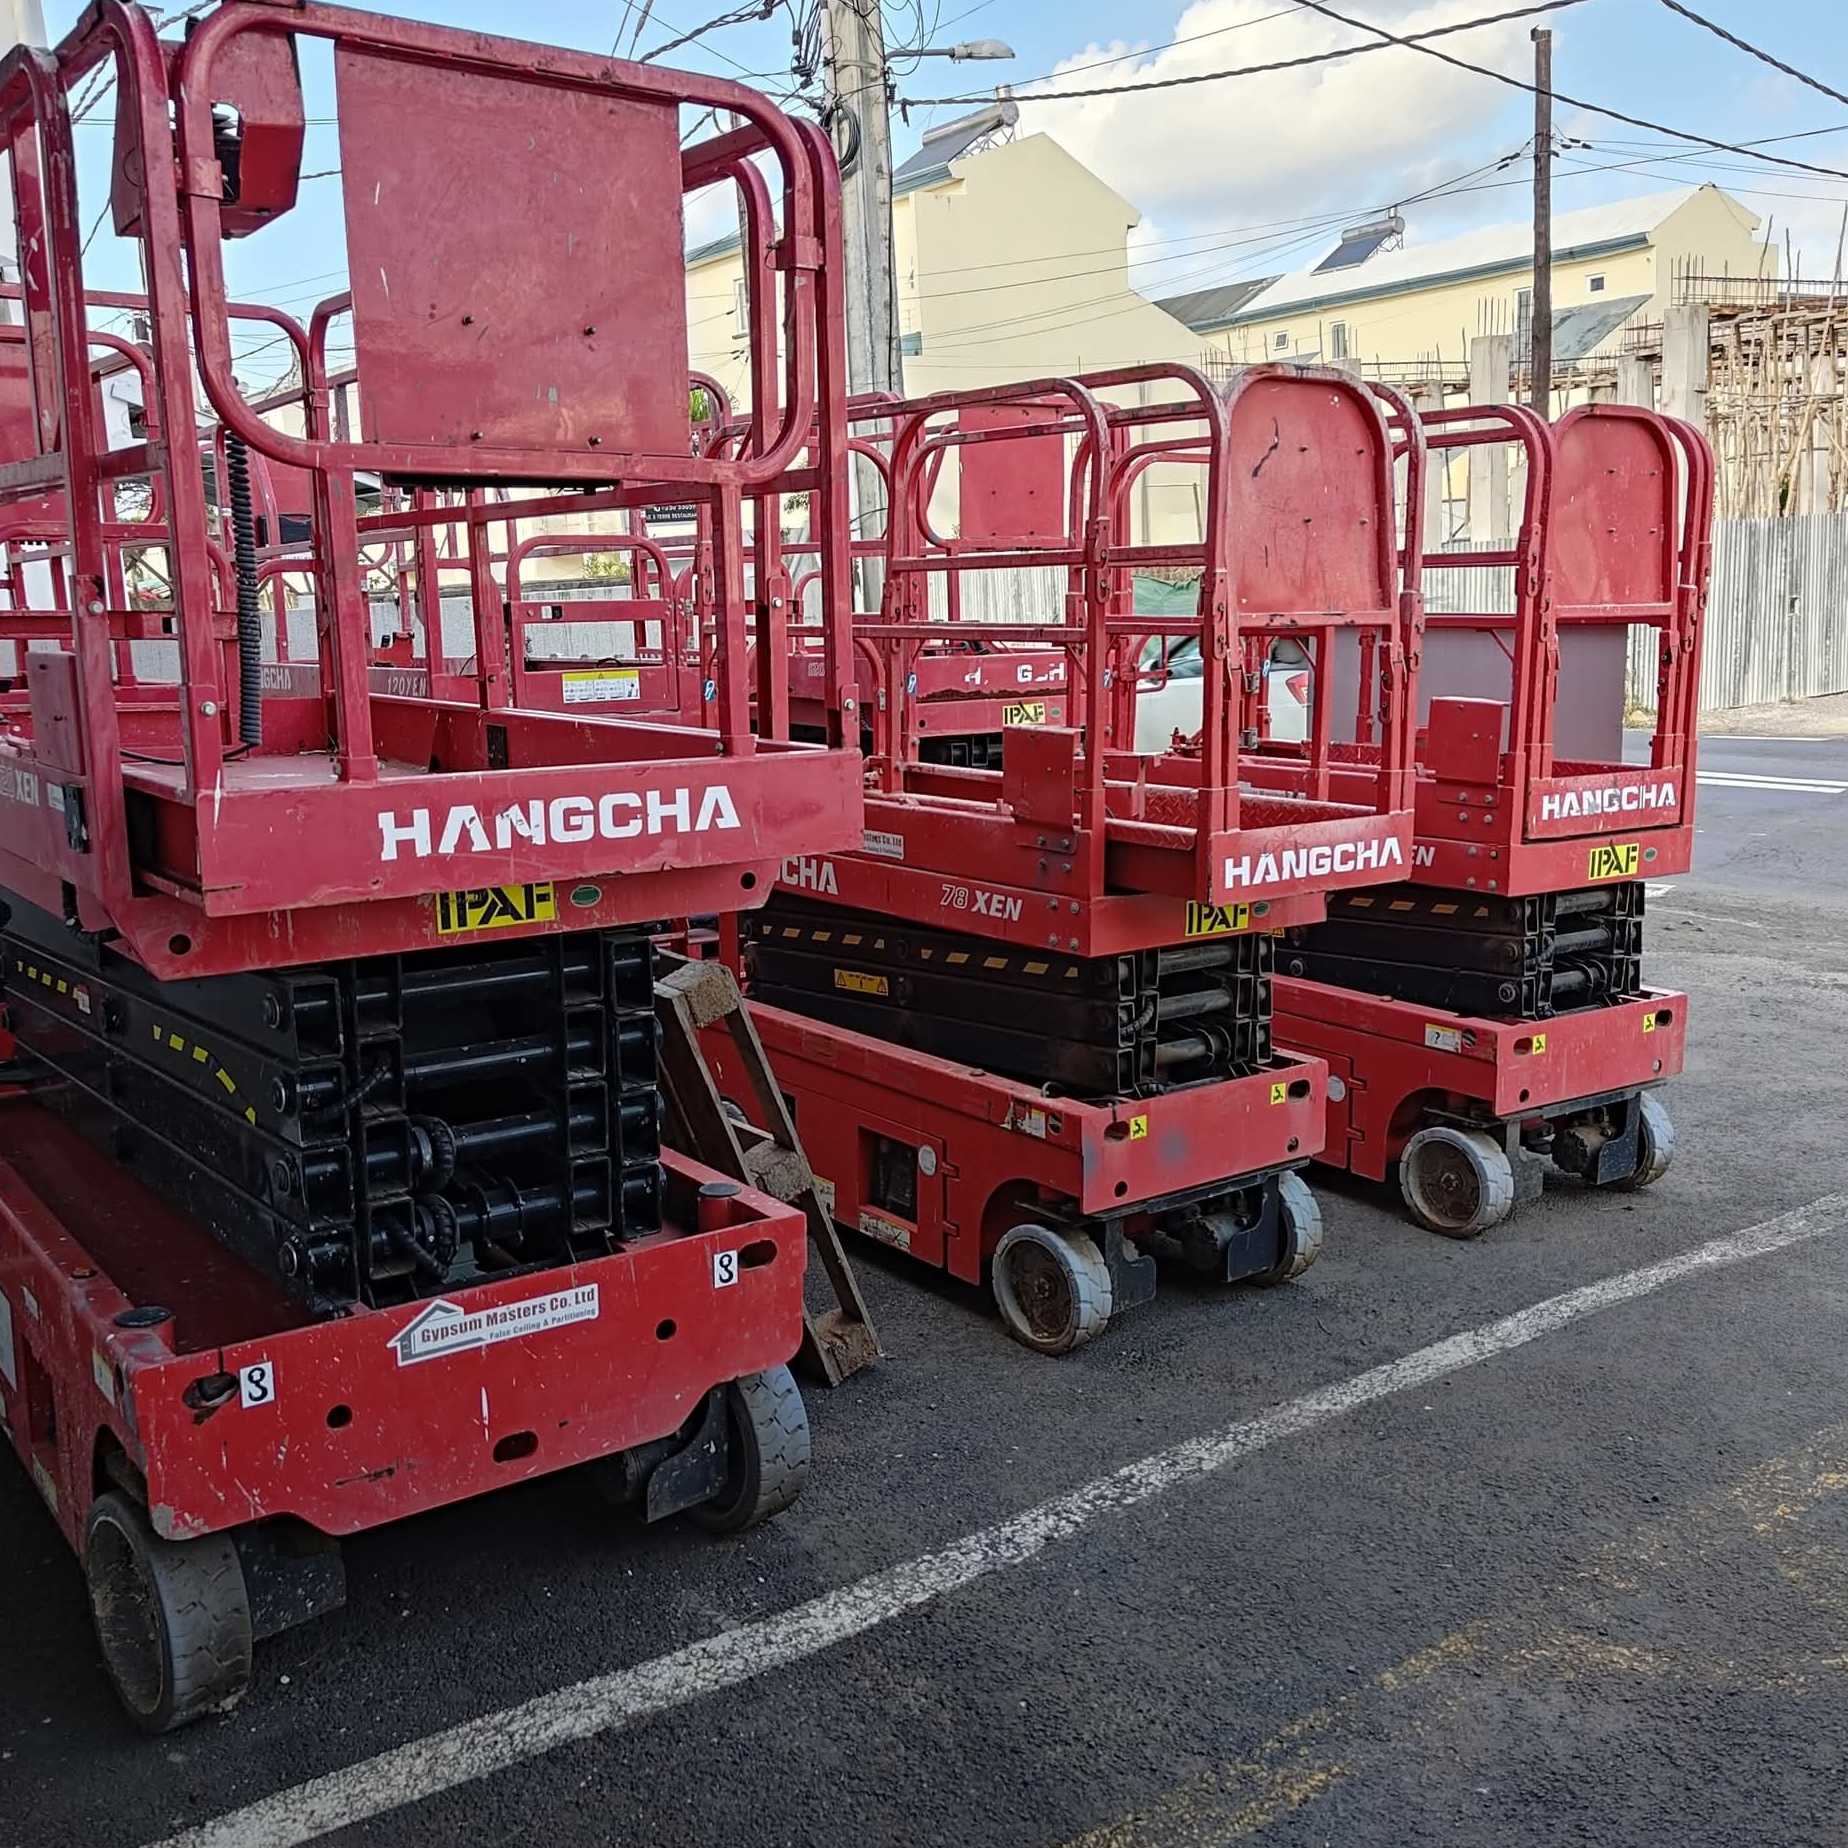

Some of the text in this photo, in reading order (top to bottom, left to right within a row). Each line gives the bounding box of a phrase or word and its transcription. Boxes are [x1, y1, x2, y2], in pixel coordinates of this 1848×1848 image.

[1004, 702, 1044, 725] IPAF
[1541, 782, 1676, 821] HANGCHA
[377, 785, 741, 861] HANGCHA
[1224, 837, 1402, 889] HANGCHA
[1589, 840, 1638, 878] IPAF
[438, 881, 551, 930] IPAF
[940, 883, 1023, 921] 78 XEN
[1187, 903, 1248, 934] IPAF
[421, 1288, 595, 1343] Gypsum Masters Co. Ltd
